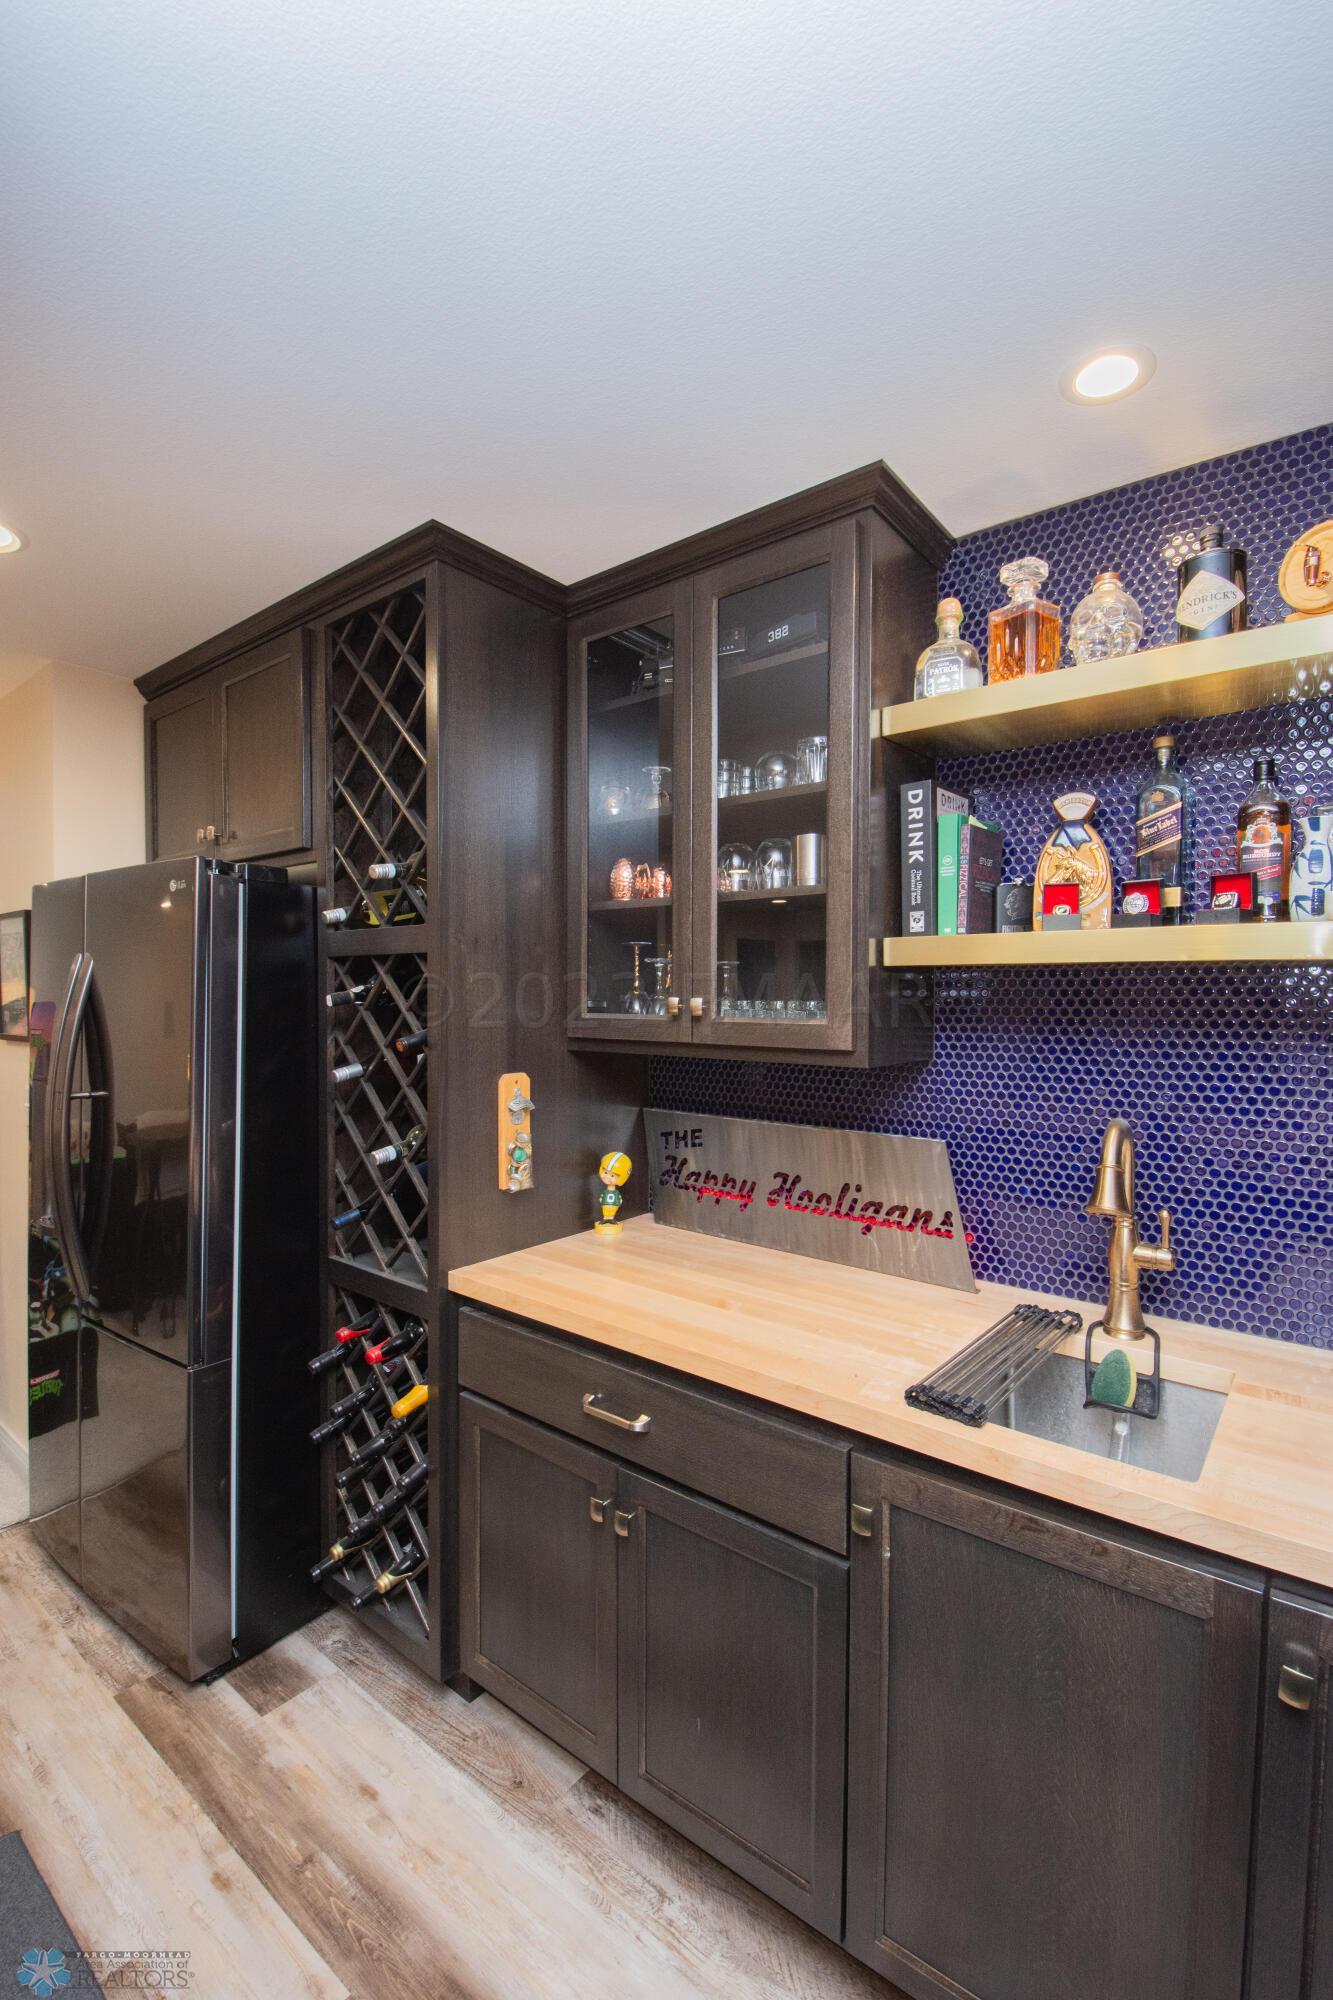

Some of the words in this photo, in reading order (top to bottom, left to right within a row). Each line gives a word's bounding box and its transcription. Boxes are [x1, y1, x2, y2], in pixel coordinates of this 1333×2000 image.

[907, 789, 924, 864] DRINK
[958, 864, 969, 898] FIZZICAL
[660, 1128, 703, 1150] THE
[659, 1154, 757, 1212] Happy
[766, 1171, 954, 1239] Hooligans
